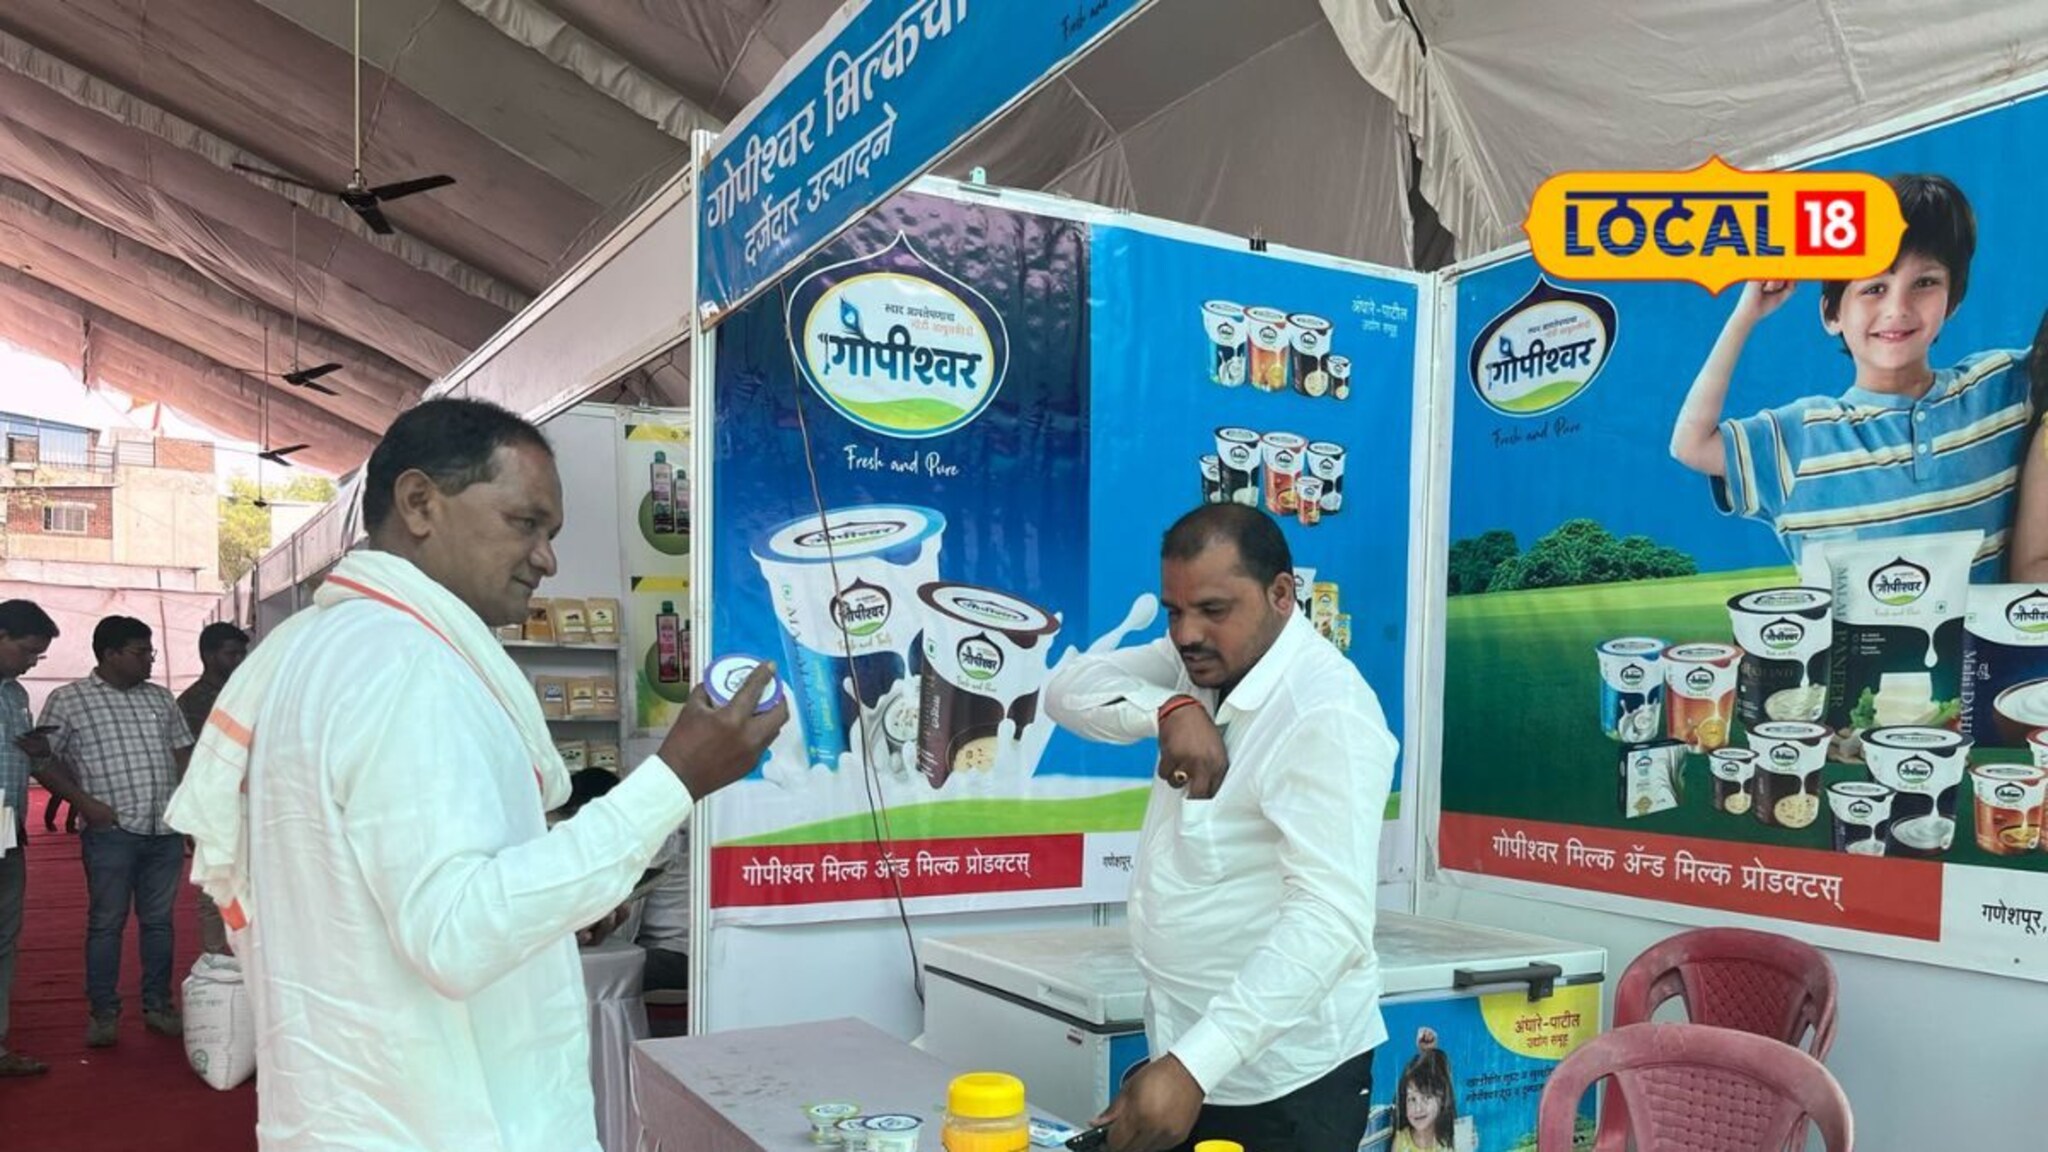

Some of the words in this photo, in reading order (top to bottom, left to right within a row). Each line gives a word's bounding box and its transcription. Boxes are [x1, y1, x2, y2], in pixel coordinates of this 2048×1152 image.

[707, 99, 817, 228] गोपीश्वर
[744, 193, 801, 266] दर्जेदार
[806, 102, 898, 213] उत्पादने
[820, 324, 982, 389] गोपीश्वर
[1485, 337, 1597, 386] गोपीश्वर
[843, 444, 884, 471] Fresh
[890, 450, 918, 474] and
[924, 451, 959, 478] Pure
[1963, 650, 1978, 688] Malai
[742, 856, 815, 886] गोपीश्वर
[821, 855, 868, 883] मिल्क
[916, 851, 960, 877] मिल्क
[966, 848, 1031, 879] प्रोडक्टस्
[1492, 828, 1559, 865] गोपीश्वर
[1566, 837, 1616, 871] मिल्क
[1674, 850, 1733, 887] मिल्क
[1740, 857, 1844, 912] प्रोडक्टस्
[1982, 898, 2047, 935] गणेशपूर,
